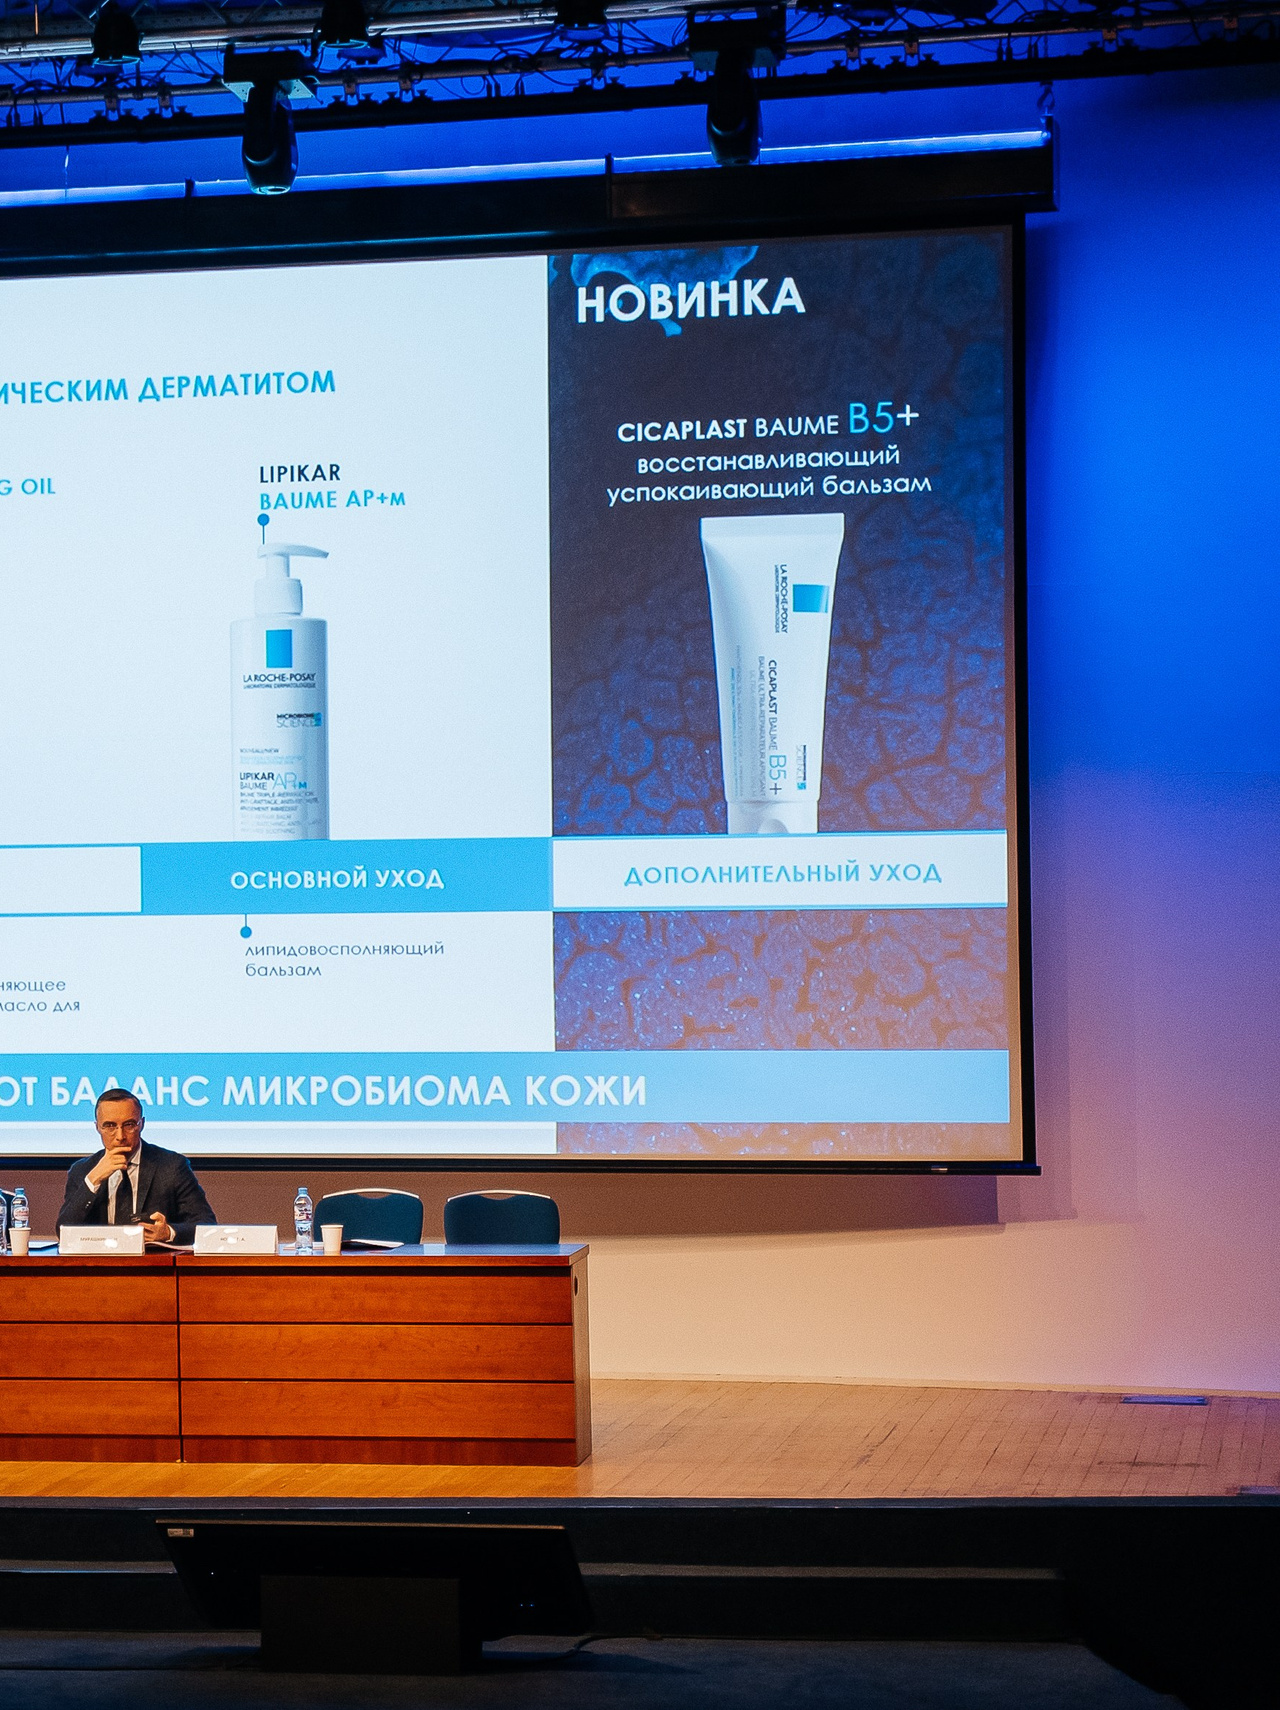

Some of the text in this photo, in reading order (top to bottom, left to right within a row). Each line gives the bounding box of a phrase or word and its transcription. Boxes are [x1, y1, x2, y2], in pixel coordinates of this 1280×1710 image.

[577, 277, 806, 323] НОВИНКА
[138, 370, 335, 402] ДЕРМАТИТОМ
[618, 402, 919, 442] CICAPLAST BAUME B5+
[638, 445, 899, 473] восстанавливающий
[21, 478, 55, 495] OIL
[260, 464, 340, 483] LIPIKAR
[261, 491, 336, 510] BAUME
[607, 475, 931, 507] успокаивающий бальзам
[254, 672, 316, 682] ROCHE-POSAY
[768, 660, 777, 714] CICAPLAST
[769, 754, 787, 795] B5+
[231, 865, 444, 889] ОСНОВНОЙ УХОД
[624, 860, 942, 886] ДОПОЛНИТЕЛЬНЫЙ УХОД
[245, 942, 444, 957] липидовосполняющий
[246, 964, 321, 976] бальзам
[53, 1002, 80, 1012] для
[223, 1075, 511, 1106] МИКРОБИОМА
[527, 1075, 646, 1106] КОЖИ
